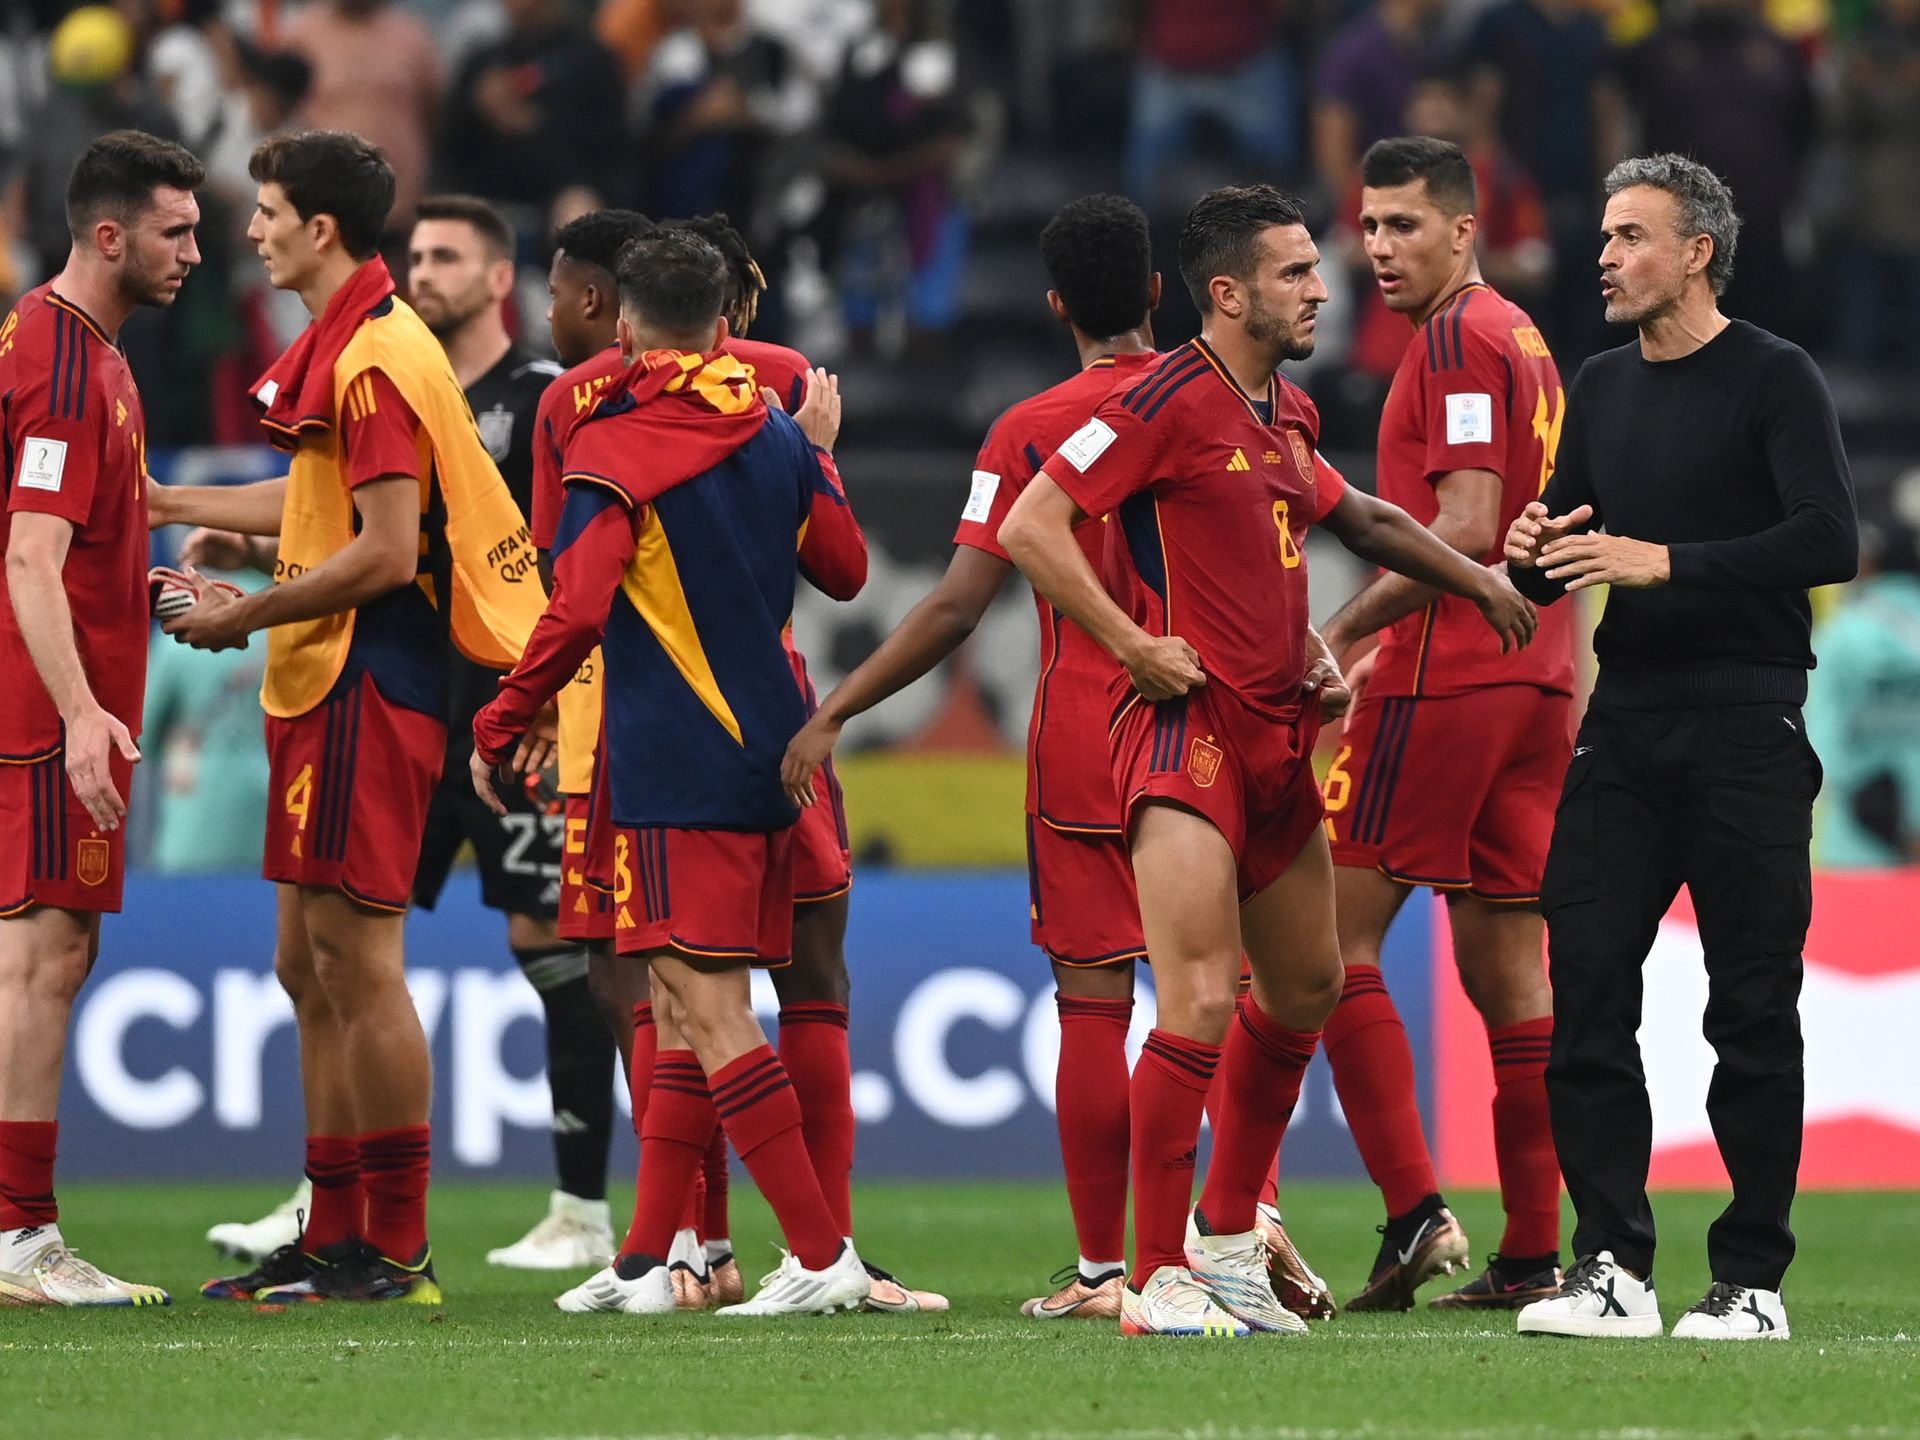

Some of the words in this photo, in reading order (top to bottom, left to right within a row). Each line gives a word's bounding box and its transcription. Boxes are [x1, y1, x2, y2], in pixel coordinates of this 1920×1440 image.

[487, 534, 520, 569] FIFA
[1272, 500, 1300, 569] 8
[500, 550, 538, 584] Qat
[286, 763, 313, 831] 4
